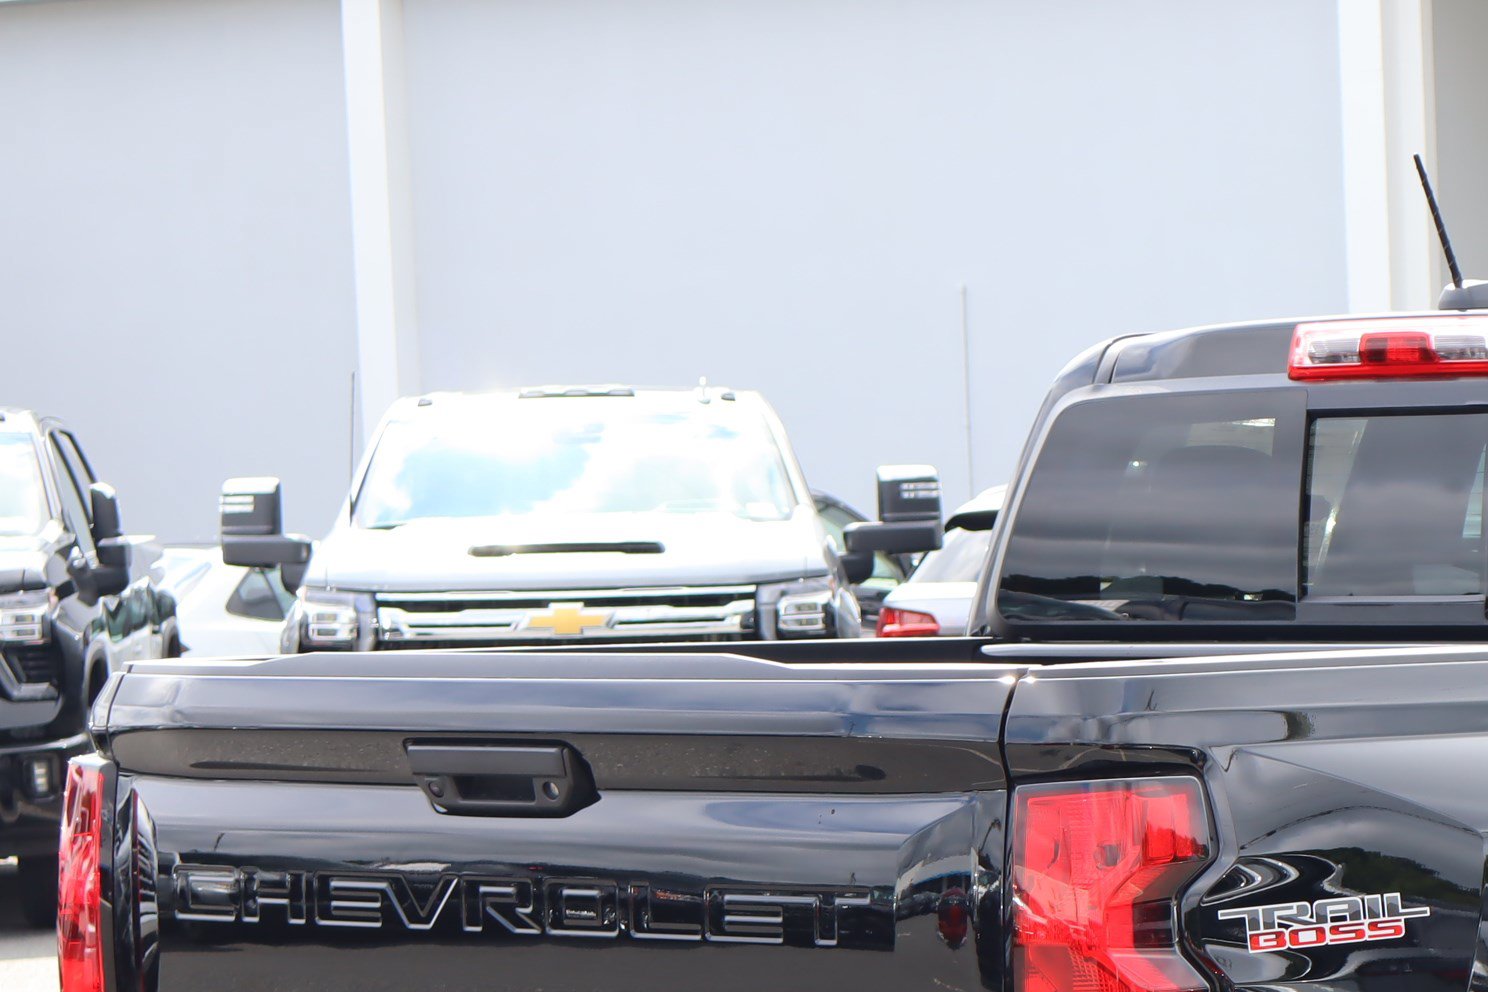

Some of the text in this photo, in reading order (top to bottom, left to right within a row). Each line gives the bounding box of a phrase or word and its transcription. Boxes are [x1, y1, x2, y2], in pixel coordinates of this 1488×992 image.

[174, 863, 872, 947] CHEVROLET
[1217, 892, 1431, 932] TRAIL
[1248, 916, 1406, 954] BOSS
